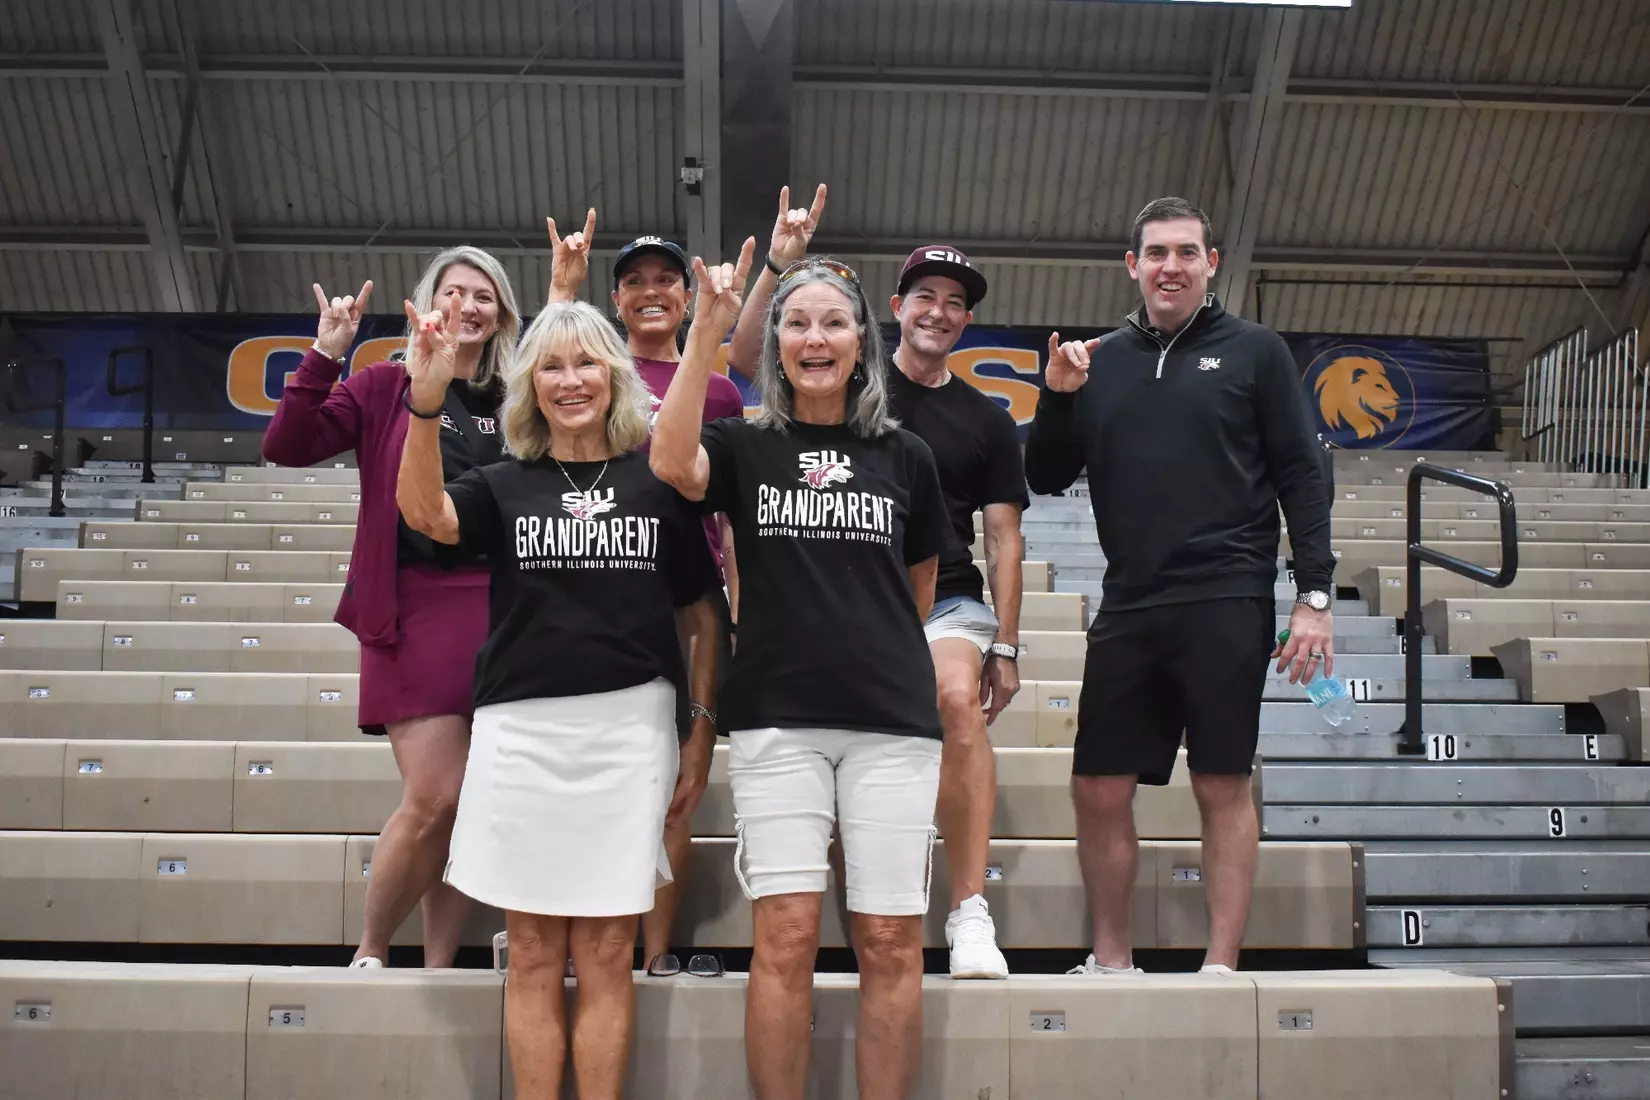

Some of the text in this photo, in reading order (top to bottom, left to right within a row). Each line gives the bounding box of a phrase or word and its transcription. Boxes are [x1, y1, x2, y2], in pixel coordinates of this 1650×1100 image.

[799, 450, 851, 469] SIU
[561, 487, 615, 509] SIU
[757, 484, 895, 535] GRANDPARENT
[3, 506, 16, 517] 16
[515, 516, 660, 559] GRANDPARENT
[758, 527, 892, 547] SOUTHERN ILLINOIS UNIVERSITY
[519, 560, 656, 571] SOUTHERN ILLINOIS UNIVERSITY
[1350, 680, 1368, 700] 11
[1432, 735, 1456, 759] 10
[1586, 735, 1597, 759] E
[1550, 808, 1563, 836] 9
[1404, 911, 1421, 945] D
